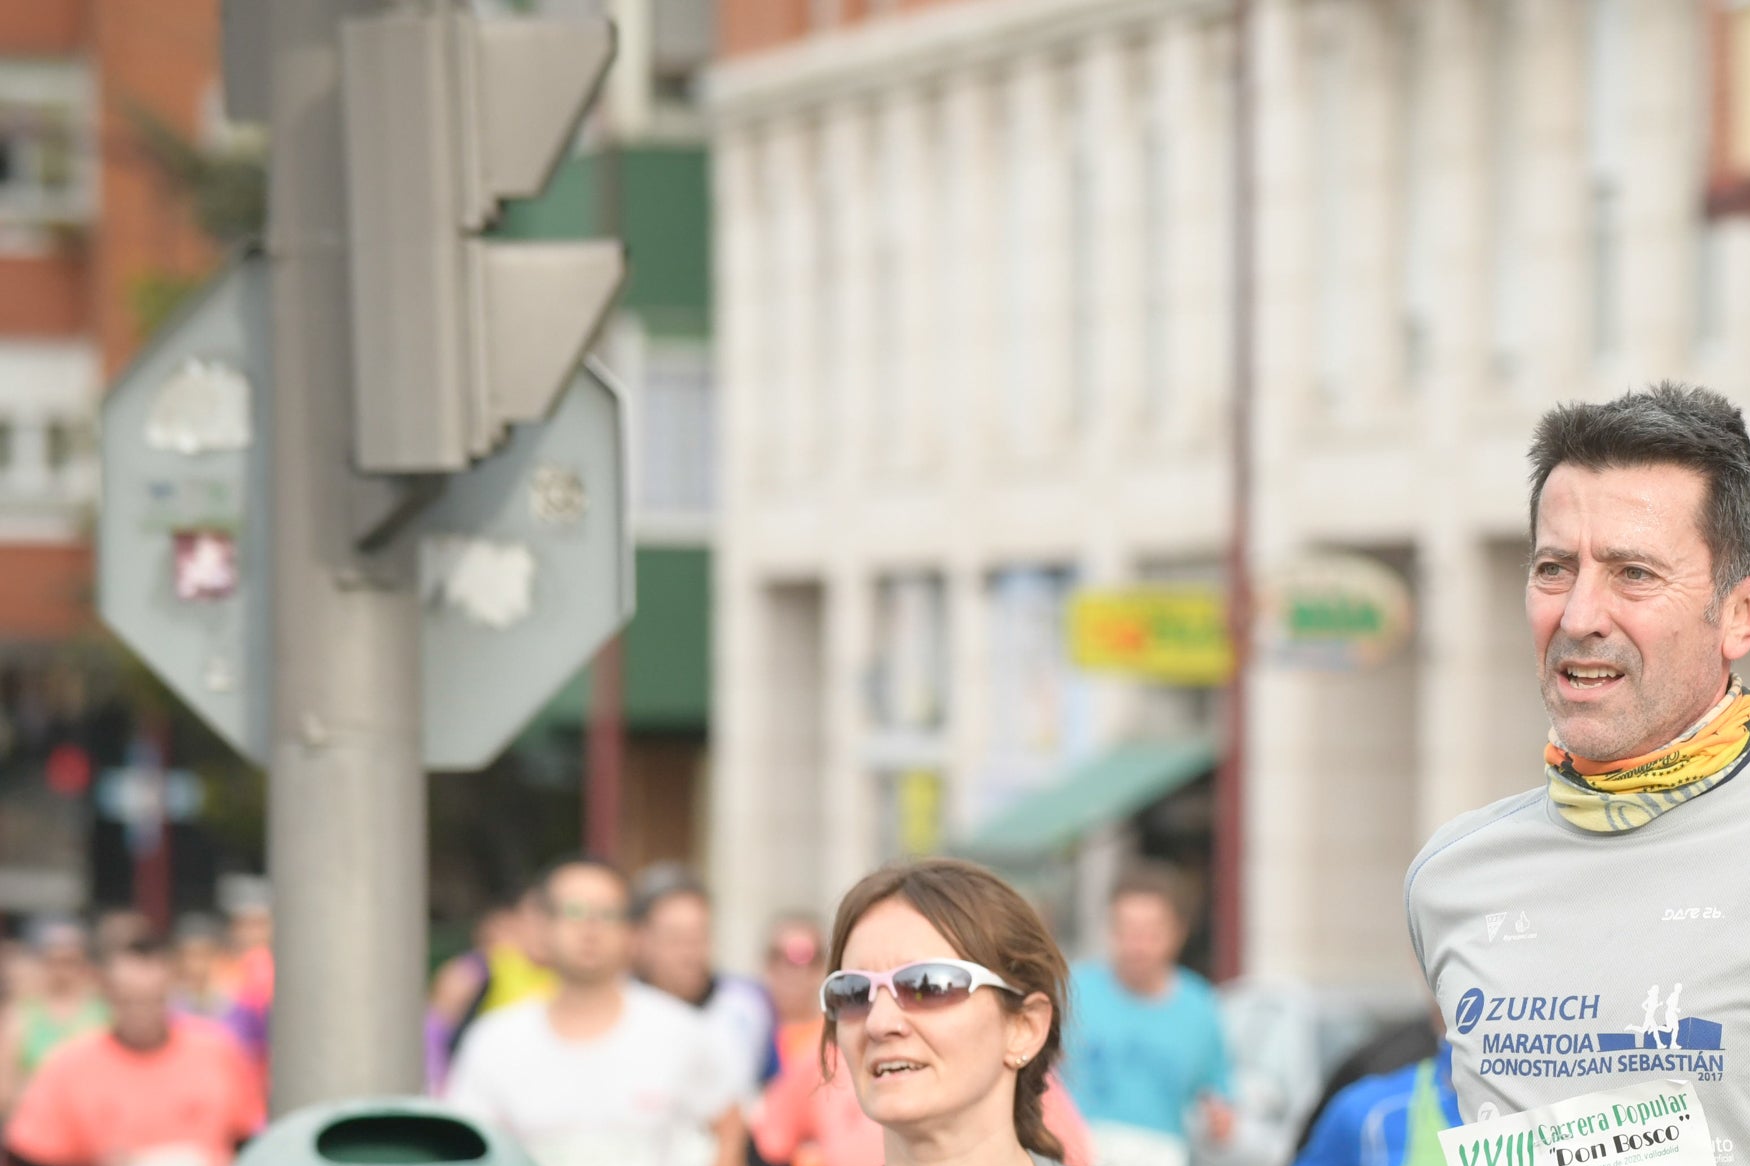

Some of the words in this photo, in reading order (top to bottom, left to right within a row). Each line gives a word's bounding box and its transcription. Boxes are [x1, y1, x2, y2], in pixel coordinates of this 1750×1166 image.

[1485, 994, 1600, 1021] ZURICH
[1482, 1033, 1594, 1054] MARATOIA
[1480, 1056, 1612, 1078] DONOSTIA/SAN
[1617, 1051, 1724, 1074] SEBASTIÁN
[1698, 1072, 1724, 1082] 2017
[1536, 1112, 1610, 1148] Carrera
[1611, 1091, 1689, 1127] Popular
